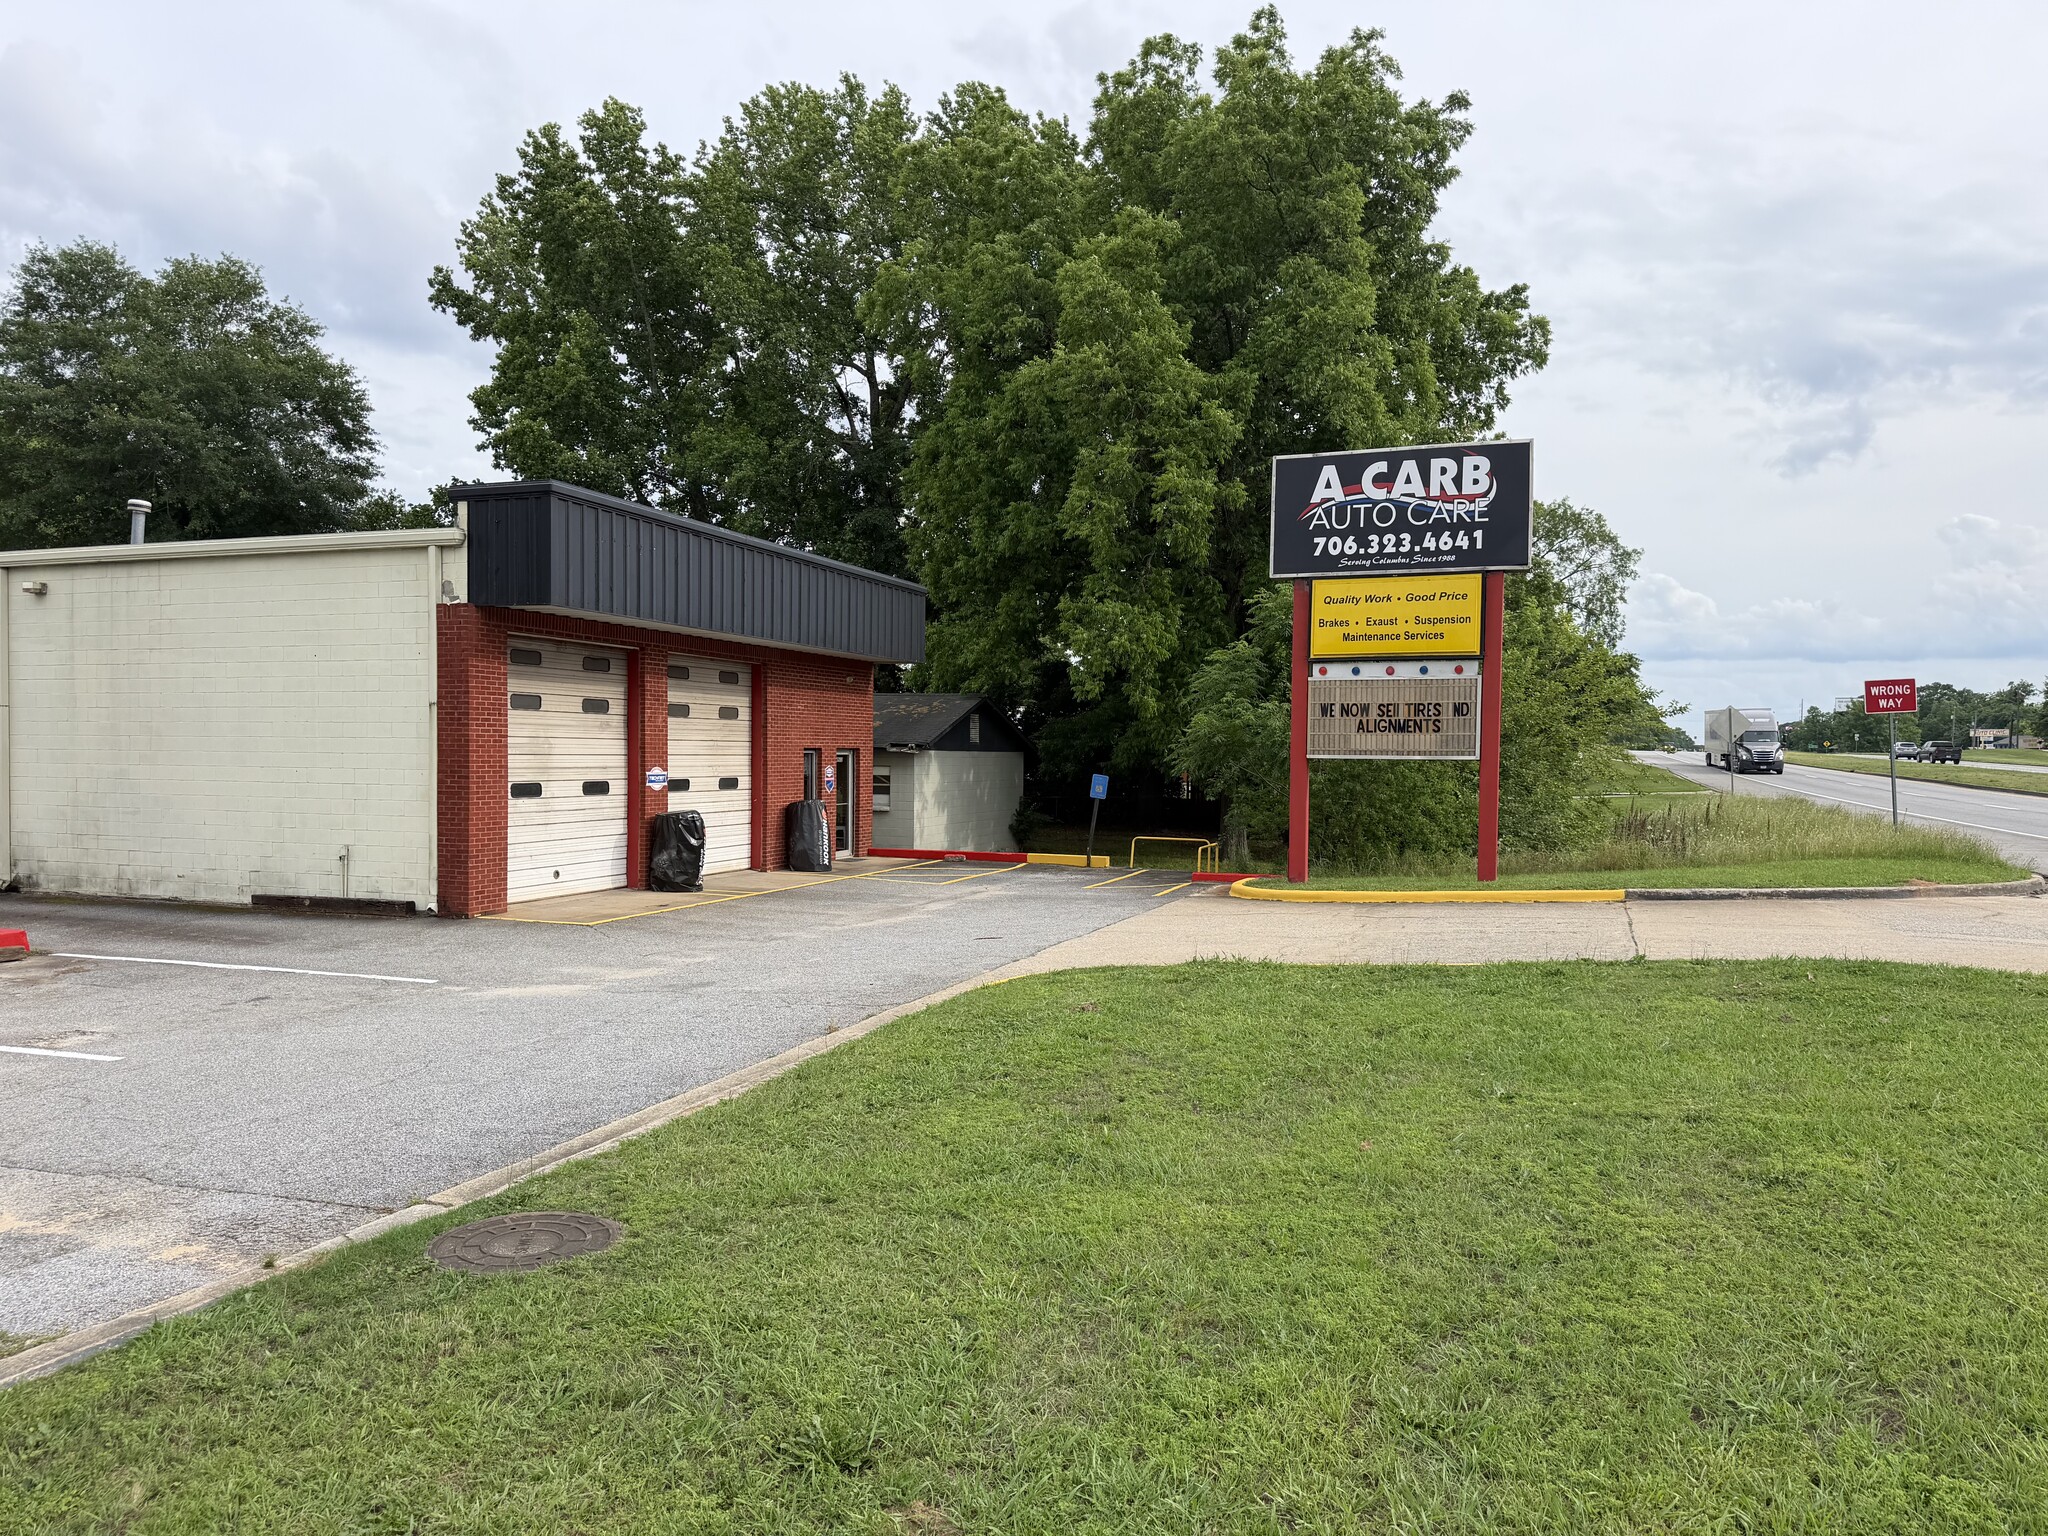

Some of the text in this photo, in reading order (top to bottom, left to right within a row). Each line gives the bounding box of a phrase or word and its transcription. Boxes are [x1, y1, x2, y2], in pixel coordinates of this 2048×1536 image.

[1309, 455, 1491, 503] A CARB
[1308, 498, 1490, 530] AUTO CARE
[1313, 530, 1483, 557] 706.323.4641
[1338, 557, 1371, 567] Serving
[1372, 555, 1409, 565] Columbus
[1411, 554, 1436, 564] Since
[1323, 591, 1468, 606] Quality Work Good Price
[1318, 614, 1471, 628] Brakes Exaust Suspension
[1342, 630, 1445, 642] Maintenance Services
[1870, 684, 1911, 696] WRONG
[1320, 702, 1335, 717] WE
[1340, 702, 1370, 717] NOW
[1405, 702, 1442, 717] TIRES
[1453, 702, 1470, 717] ND
[1878, 698, 1903, 708] WAY
[1357, 719, 1441, 734] ALIGNMENTS
